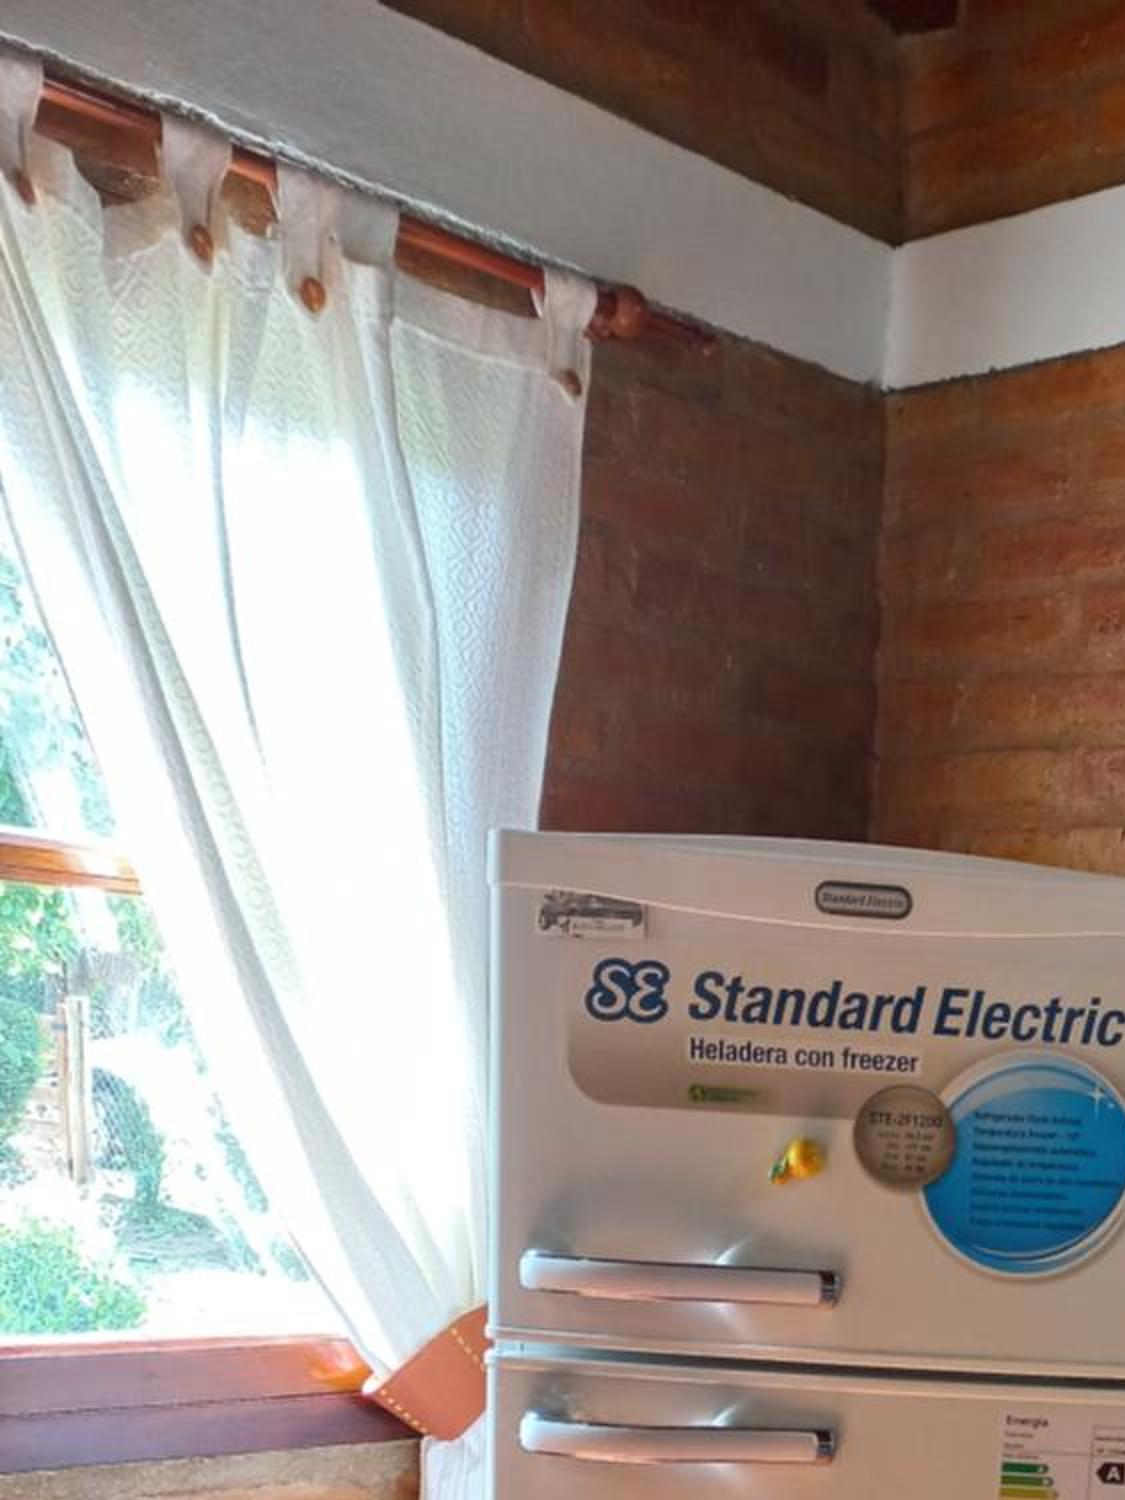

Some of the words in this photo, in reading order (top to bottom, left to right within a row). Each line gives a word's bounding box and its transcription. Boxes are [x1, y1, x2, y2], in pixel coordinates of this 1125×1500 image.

[688, 970, 927, 1034] Standard
[690, 1036, 788, 1065] Heladera
[794, 1047, 835, 1068] con
[843, 1046, 919, 1072] freezer
[1106, 1464, 1121, 1482] A
